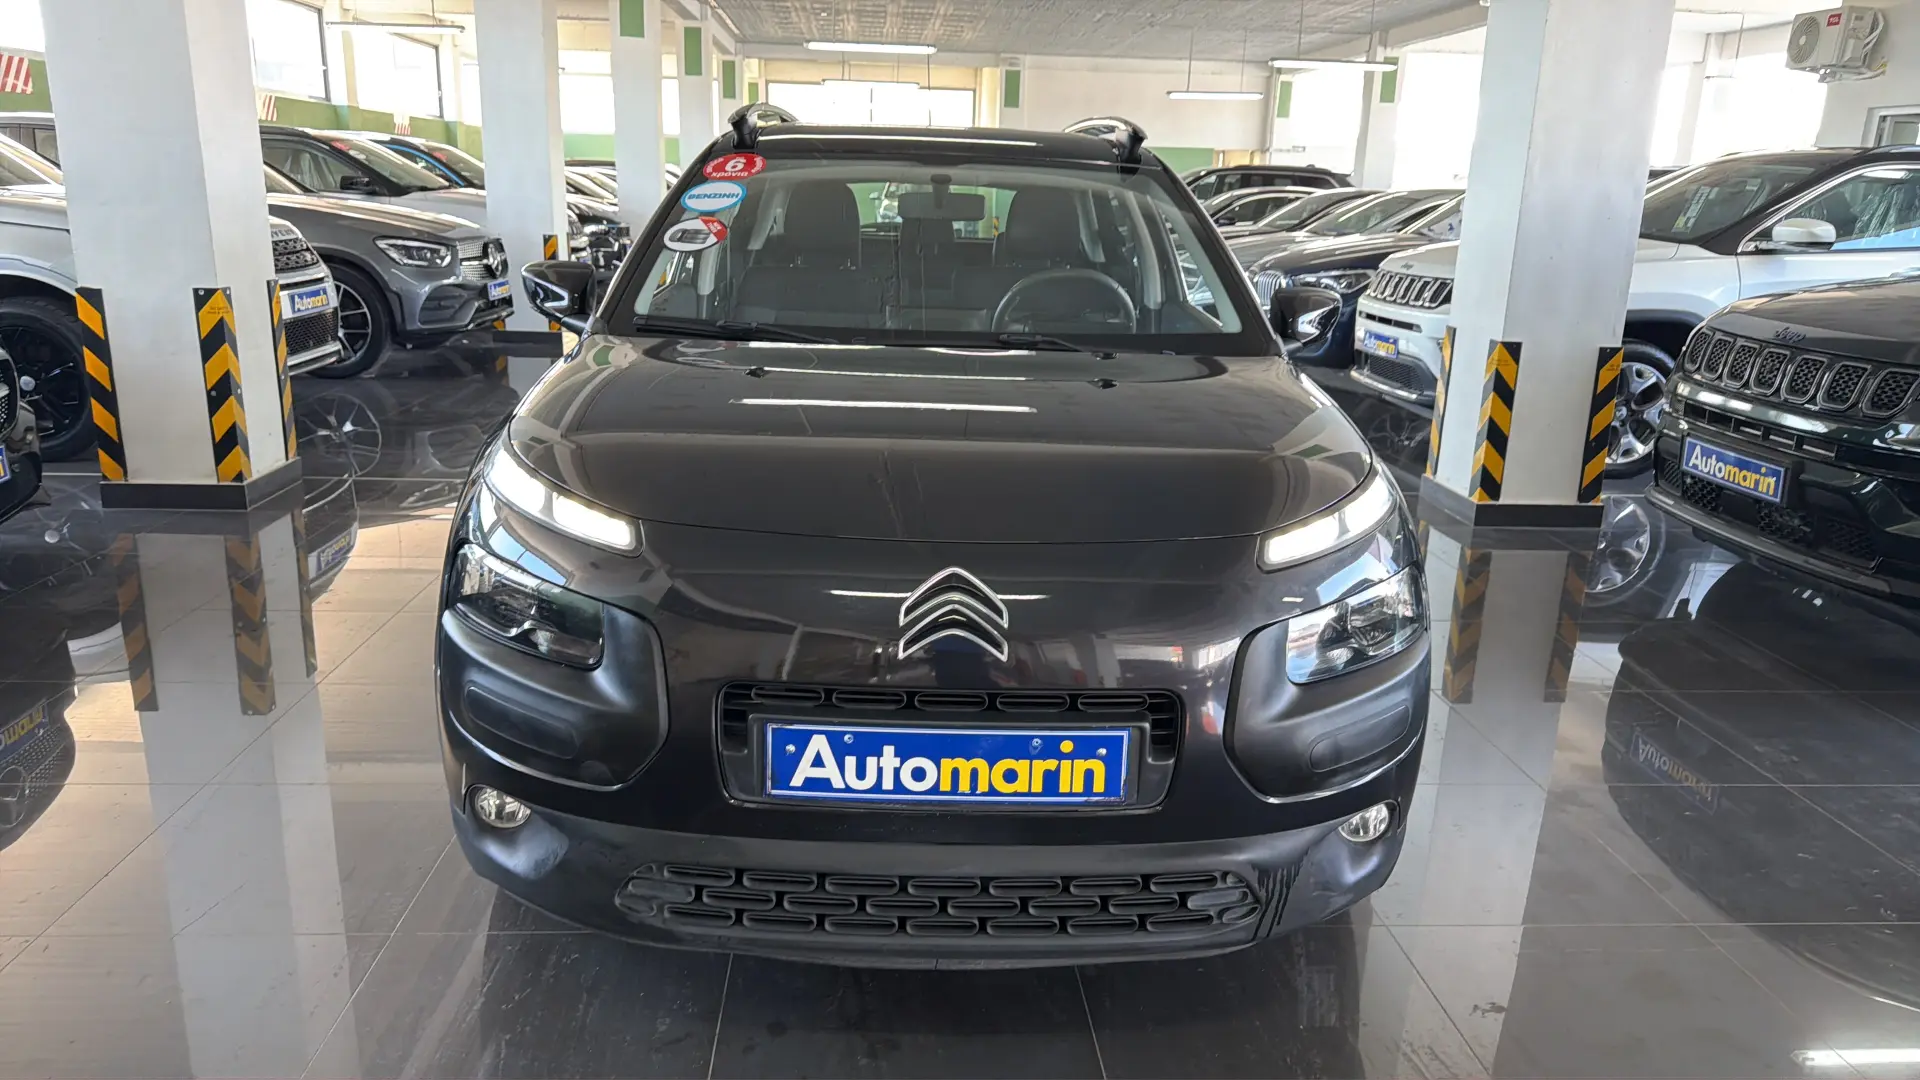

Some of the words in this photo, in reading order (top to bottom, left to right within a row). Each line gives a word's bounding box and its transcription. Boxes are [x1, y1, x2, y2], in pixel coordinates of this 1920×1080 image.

[725, 158, 746, 171] 6
[294, 290, 328, 312] Automarin
[1774, 326, 1807, 343] Jeep
[1688, 444, 1777, 496] Automarin
[789, 734, 1106, 793] Automarin
